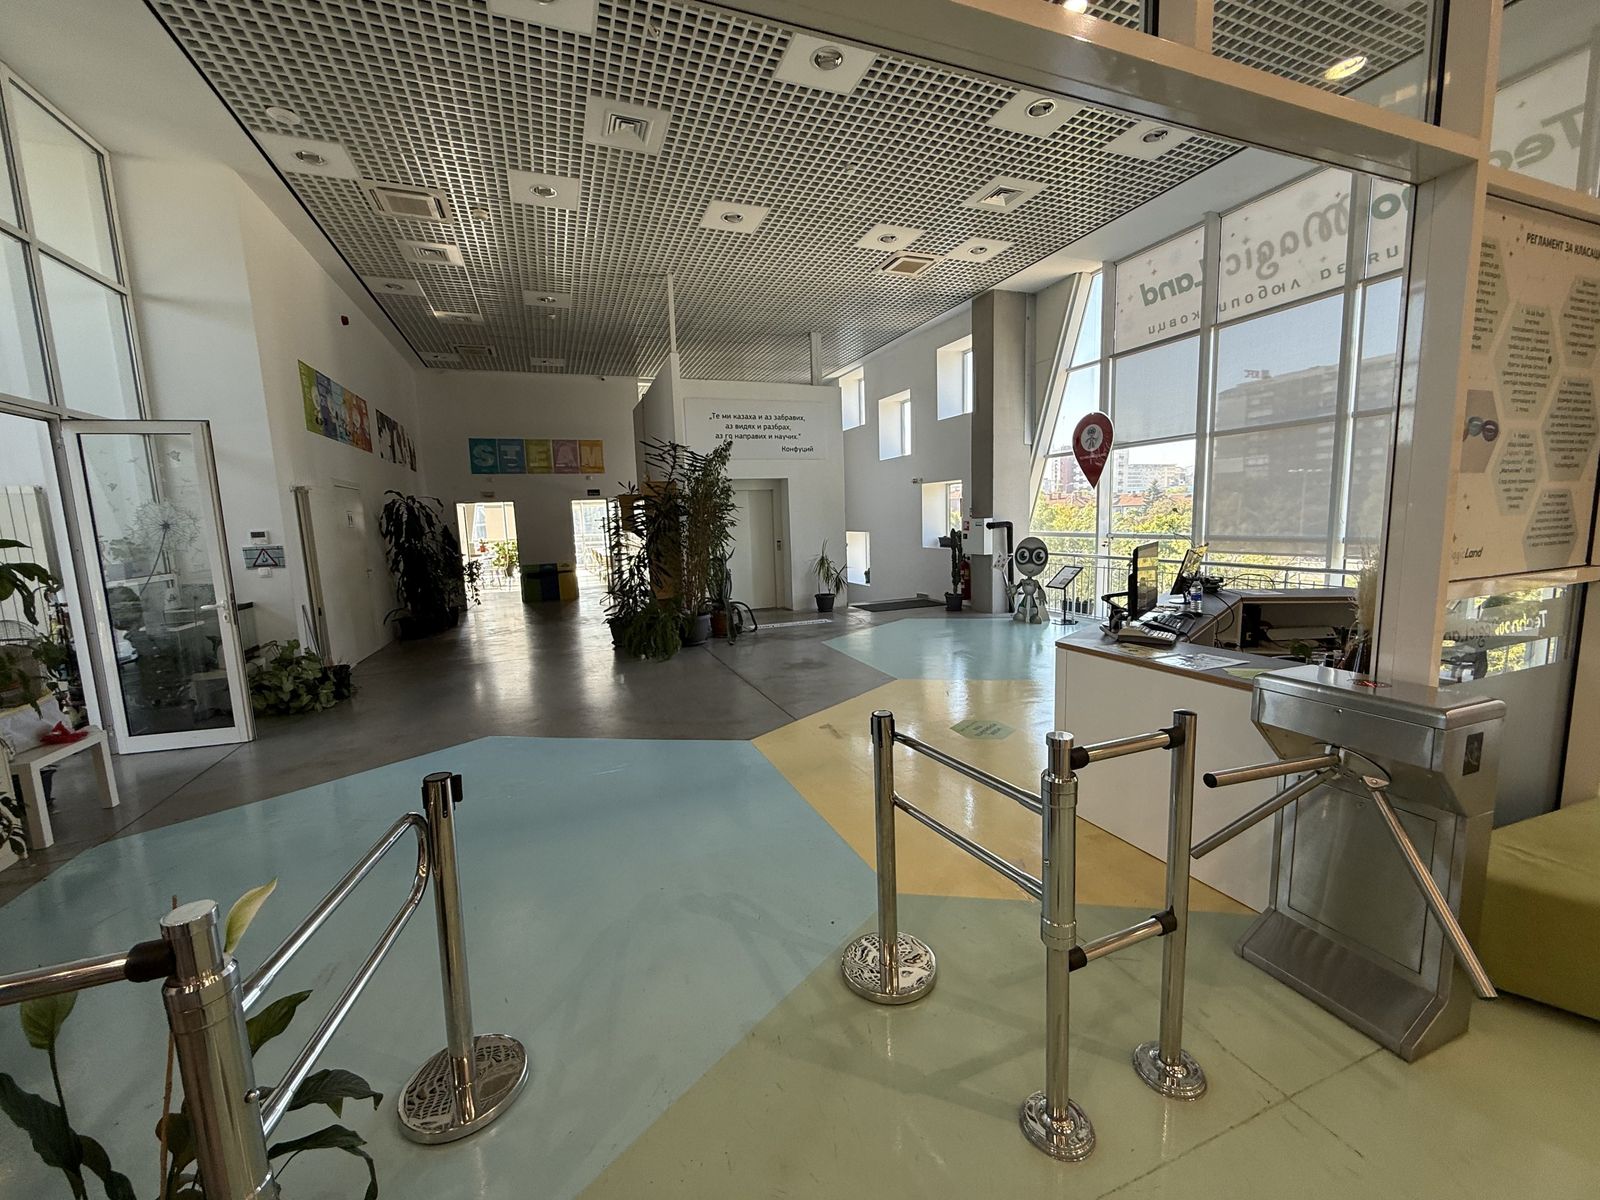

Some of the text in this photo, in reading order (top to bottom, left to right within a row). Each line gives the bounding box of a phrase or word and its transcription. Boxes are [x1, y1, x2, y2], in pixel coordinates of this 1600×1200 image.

[1526, 232, 1564, 251] РЕГЛАМЕНТ
[1564, 241, 1573, 254] ЗА
[774, 414, 805, 422] забравих,
[763, 423, 792, 431] разбрах,
[781, 445, 814, 454] Конфуций
